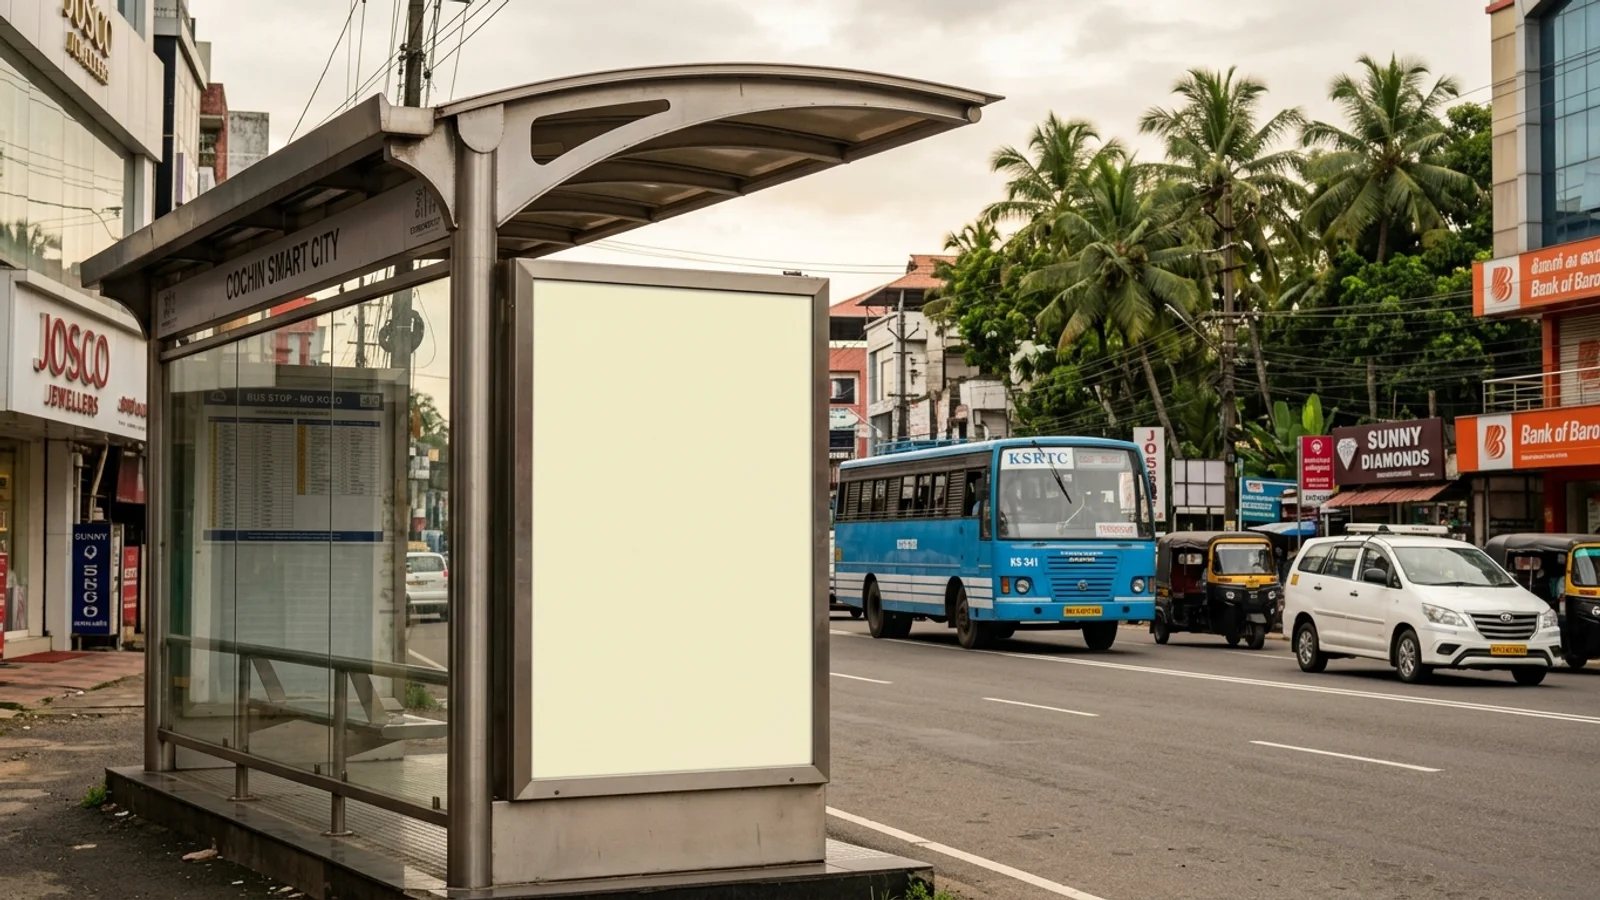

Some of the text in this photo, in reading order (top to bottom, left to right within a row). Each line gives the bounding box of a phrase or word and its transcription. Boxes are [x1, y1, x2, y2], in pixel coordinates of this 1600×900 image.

[226, 228, 340, 301] COCHIN SMART CITY
[1531, 276, 1559, 297] Bank
[1561, 273, 1574, 292] of
[37, 313, 109, 388] JOSCO
[44, 384, 98, 416] JEWELLERS
[246, 393, 266, 402] BUS
[268, 393, 292, 403] STOP
[1368, 426, 1422, 449] SUNNY
[1521, 422, 1552, 445] Bank
[1555, 421, 1569, 442] of
[1009, 452, 1068, 464] KSRTC
[1361, 449, 1429, 469] DIAMONDS
[75, 533, 107, 541] SUNNY
[1010, 557, 1038, 567] KS 341
